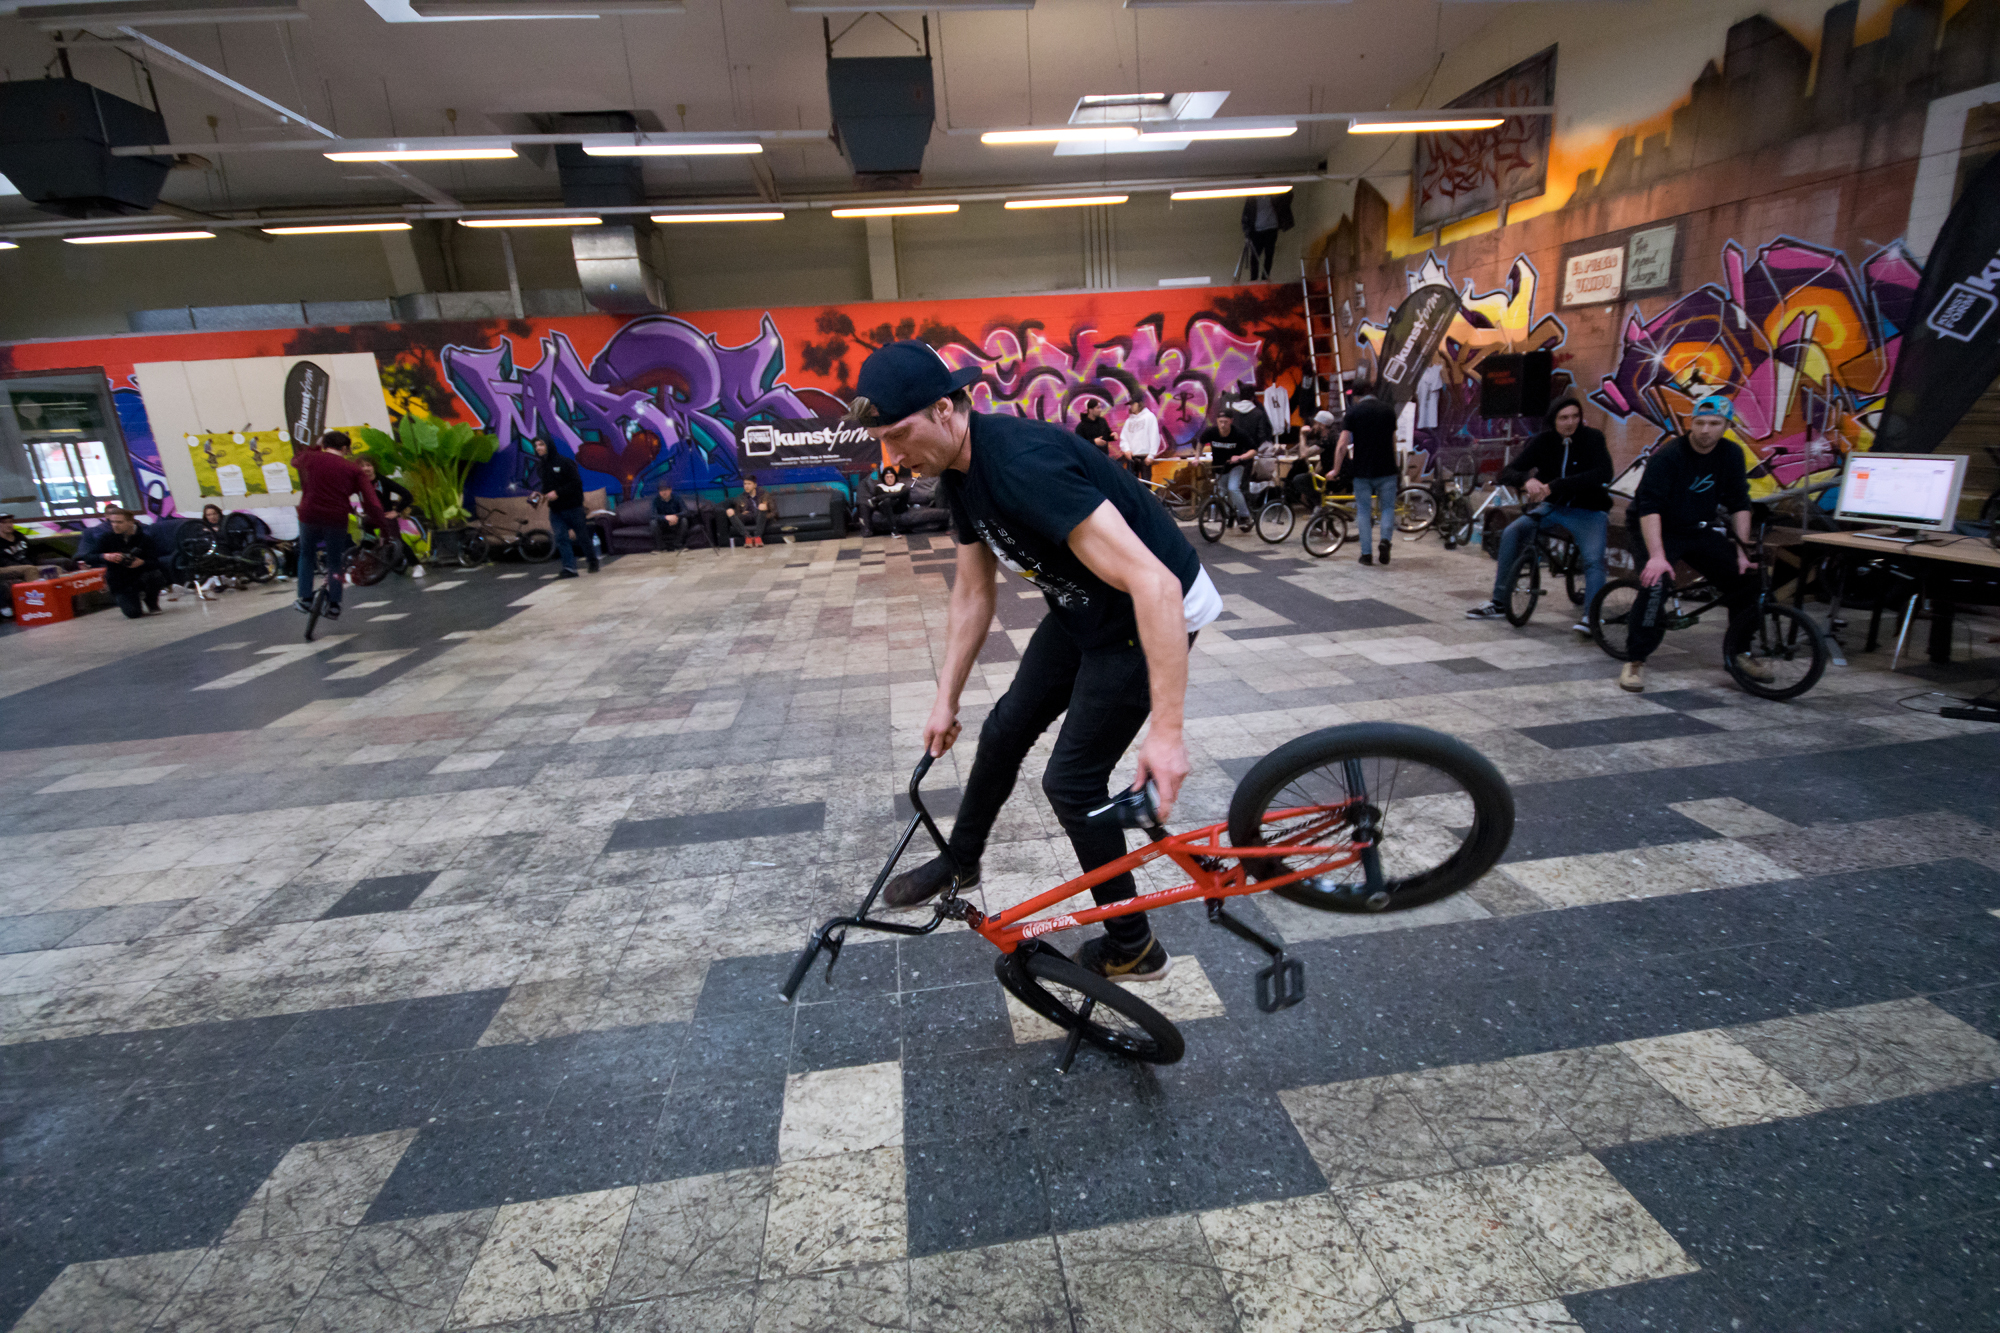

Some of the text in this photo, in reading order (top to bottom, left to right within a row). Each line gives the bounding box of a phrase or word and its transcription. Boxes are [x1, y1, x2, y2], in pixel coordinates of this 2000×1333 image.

[1575, 274, 1613, 294] UNIDO
[1394, 292, 1441, 363] kunstform
[21, 611, 53, 621] globe
